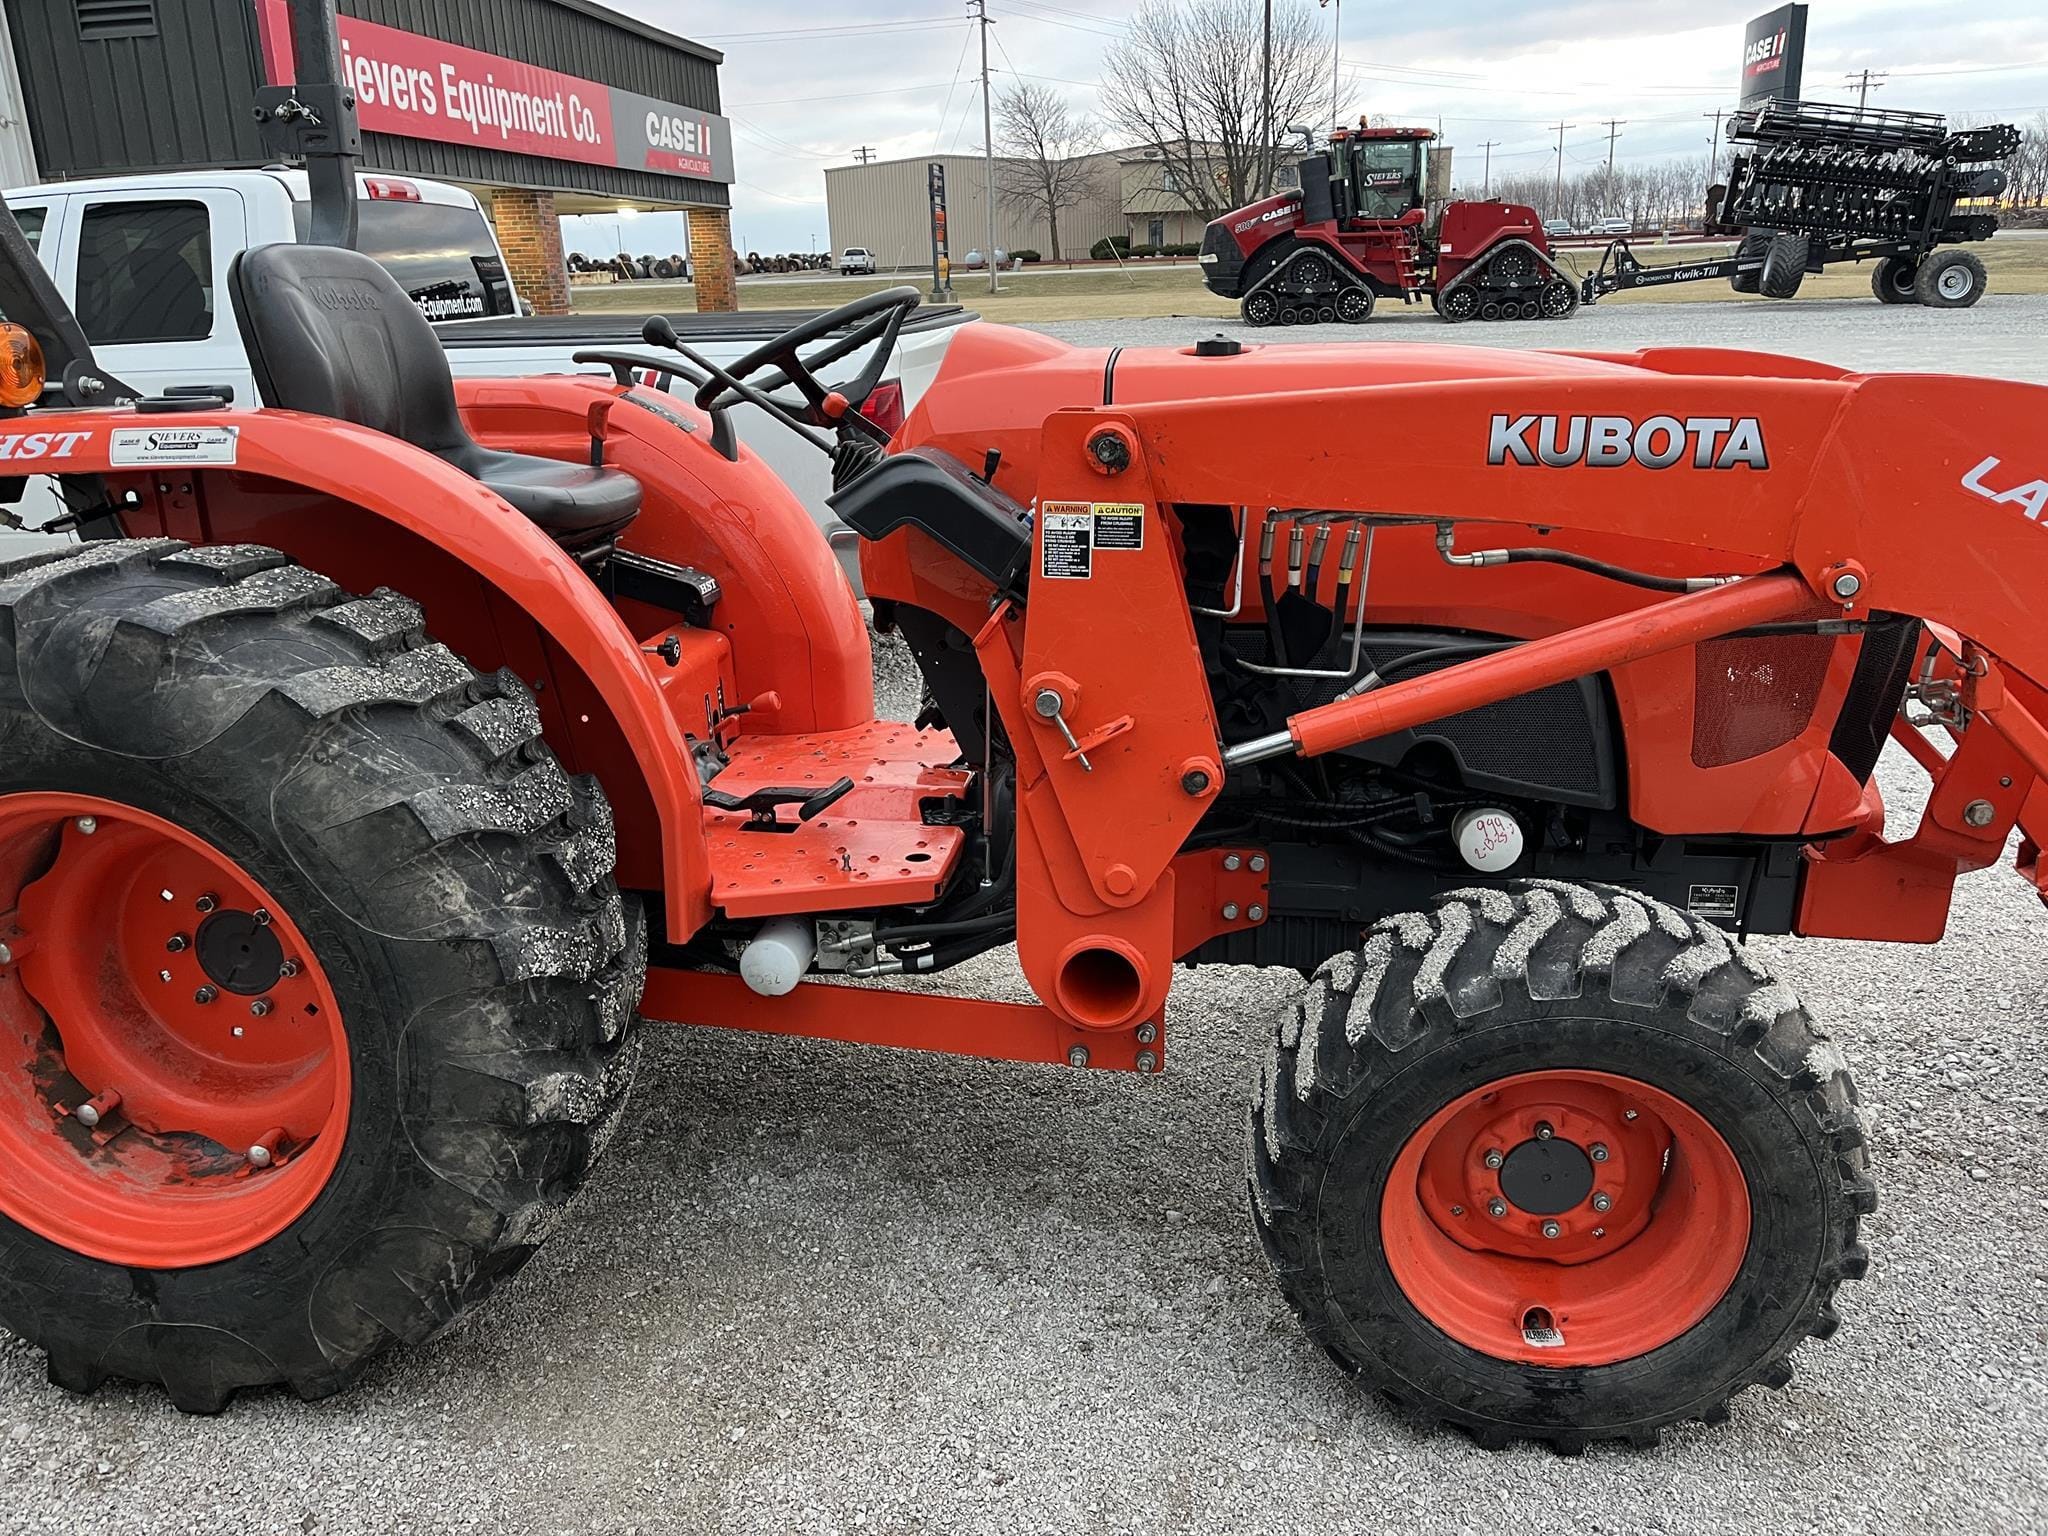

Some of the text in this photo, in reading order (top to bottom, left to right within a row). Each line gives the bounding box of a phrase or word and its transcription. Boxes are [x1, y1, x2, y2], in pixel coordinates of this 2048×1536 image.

[341, 39, 601, 145] ievers Equipment Co.
[1363, 171, 1402, 187] SIEVERS
[1673, 266, 1720, 281] Kwik-Till
[417, 294, 483, 320] sEquipment.com
[144, 432, 202, 451] SIEVERS
[1487, 414, 1769, 470] KUBOTA
[1961, 455, 2048, 529] LA
[699, 578, 717, 595] HST
